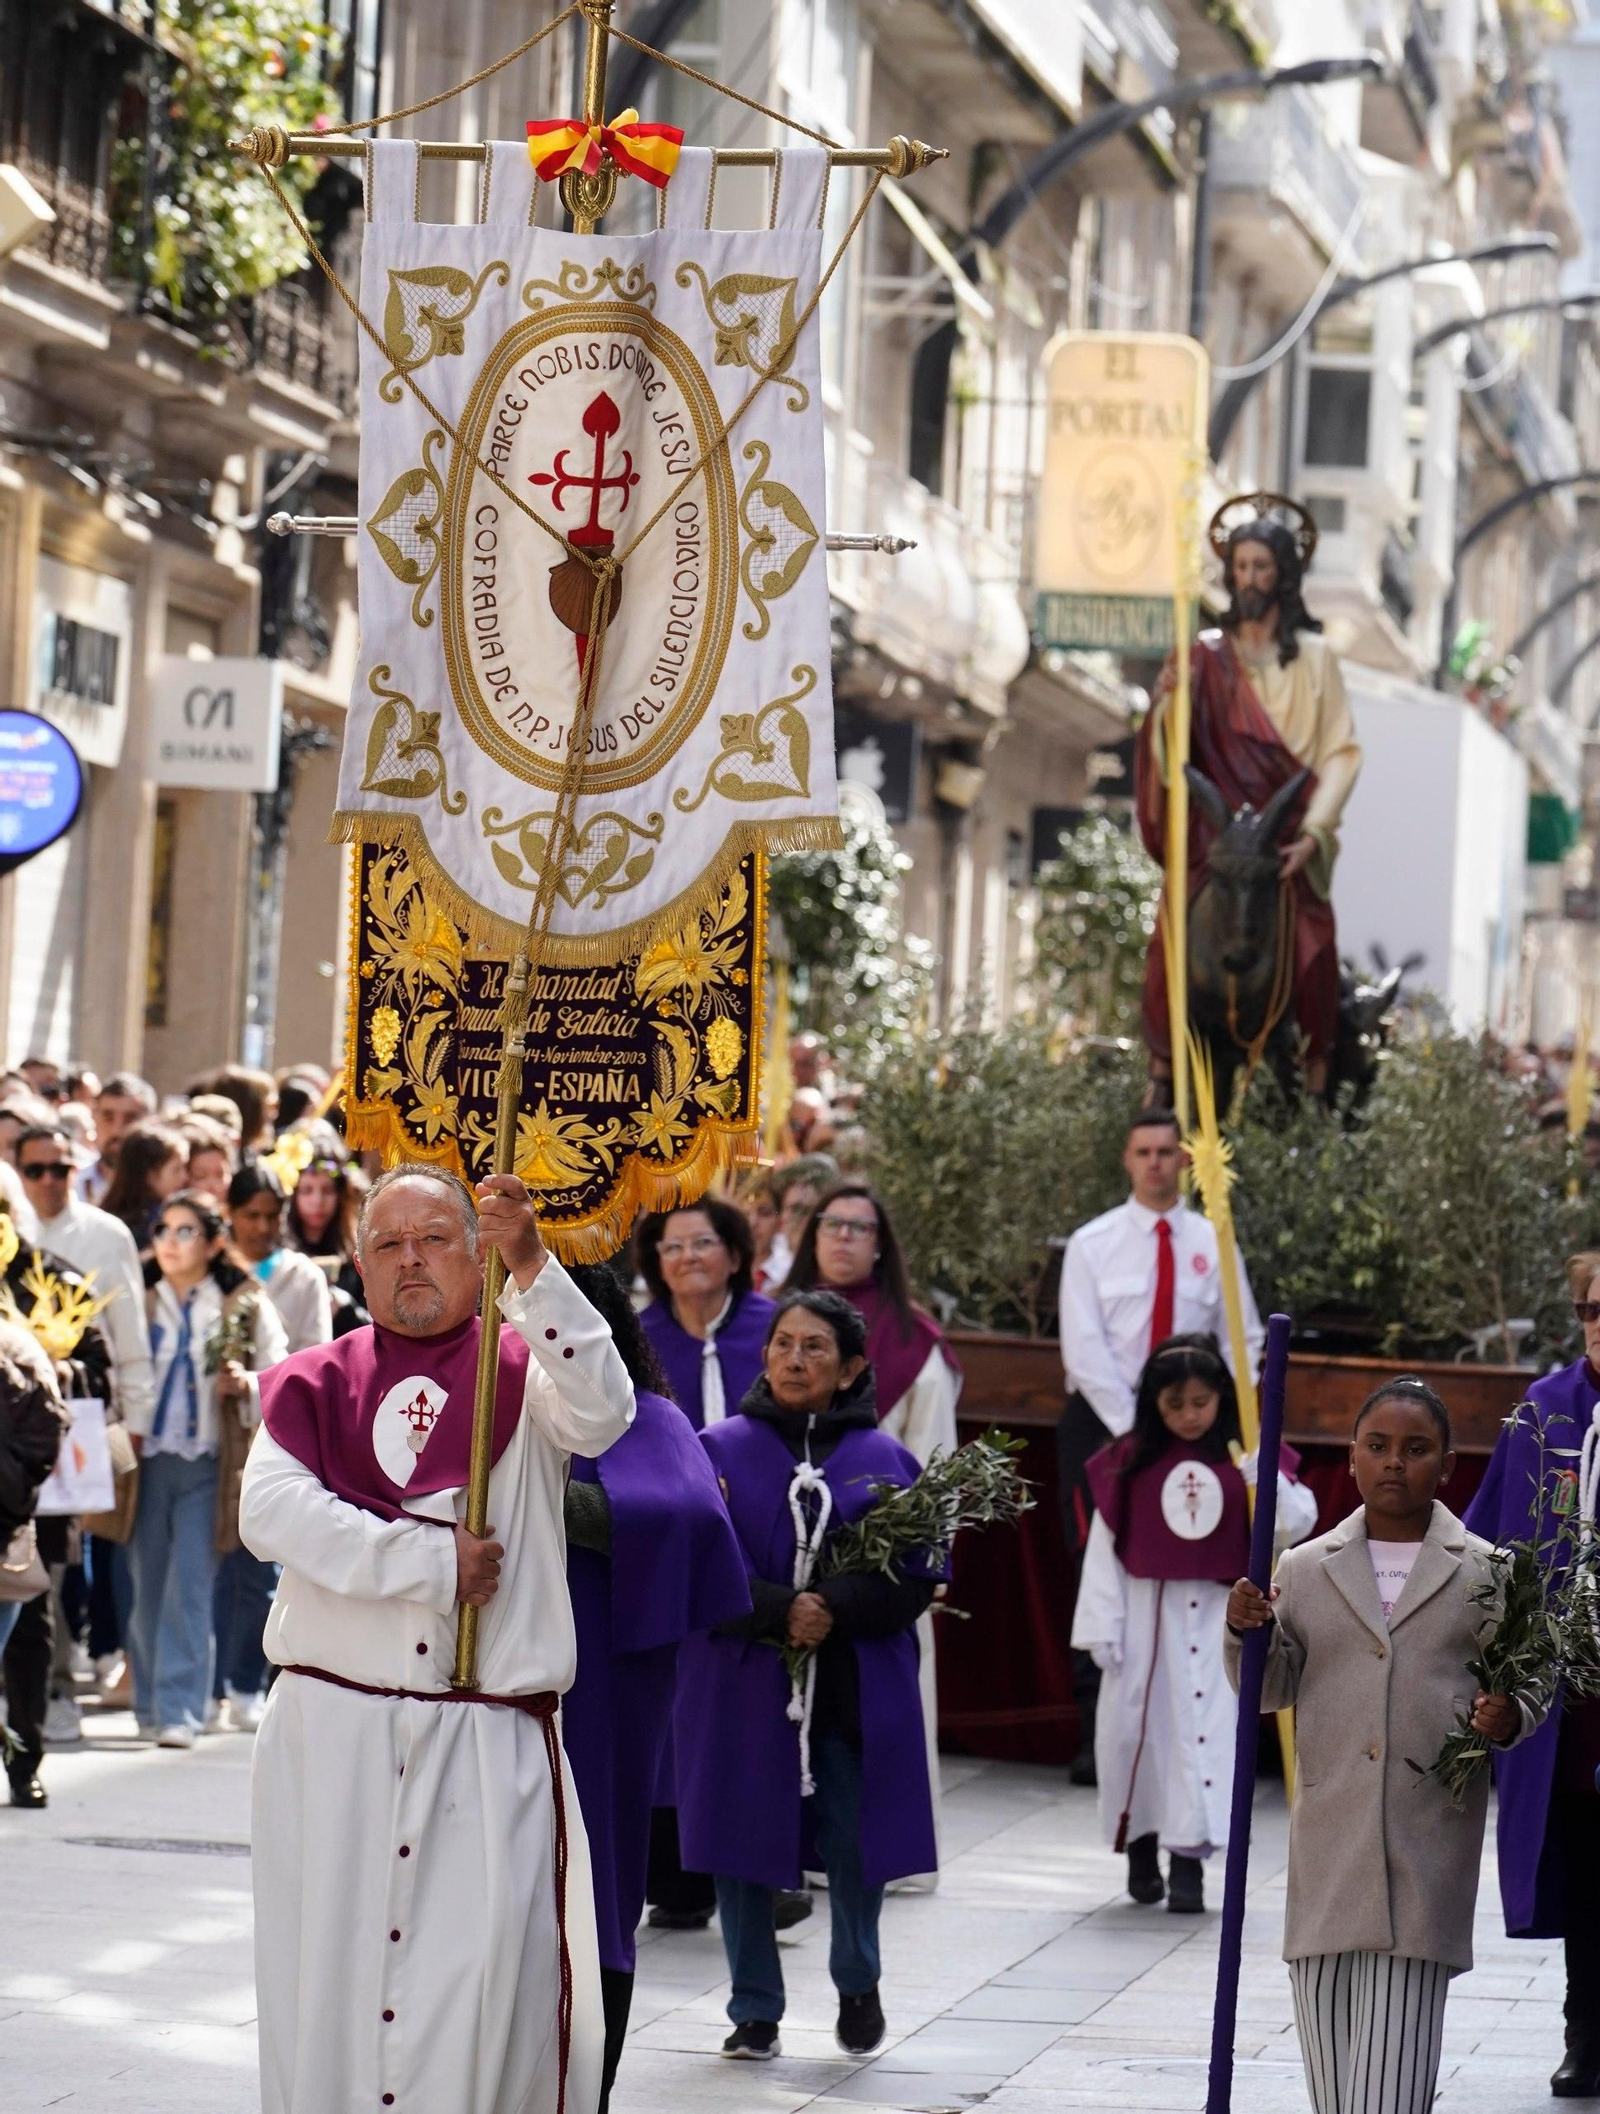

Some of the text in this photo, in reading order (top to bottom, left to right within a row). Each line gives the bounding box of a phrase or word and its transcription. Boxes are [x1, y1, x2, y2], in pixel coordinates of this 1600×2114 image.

[486, 394, 528, 478] PARCE
[653, 411, 692, 475] JESU
[473, 504, 505, 660] COFRADIA
[485, 666, 519, 702] DE
[619, 695, 665, 740] DEL
[525, 1003, 550, 1034] de
[557, 1006, 641, 1039] Galicia
[458, 1066, 523, 1097] VIG
